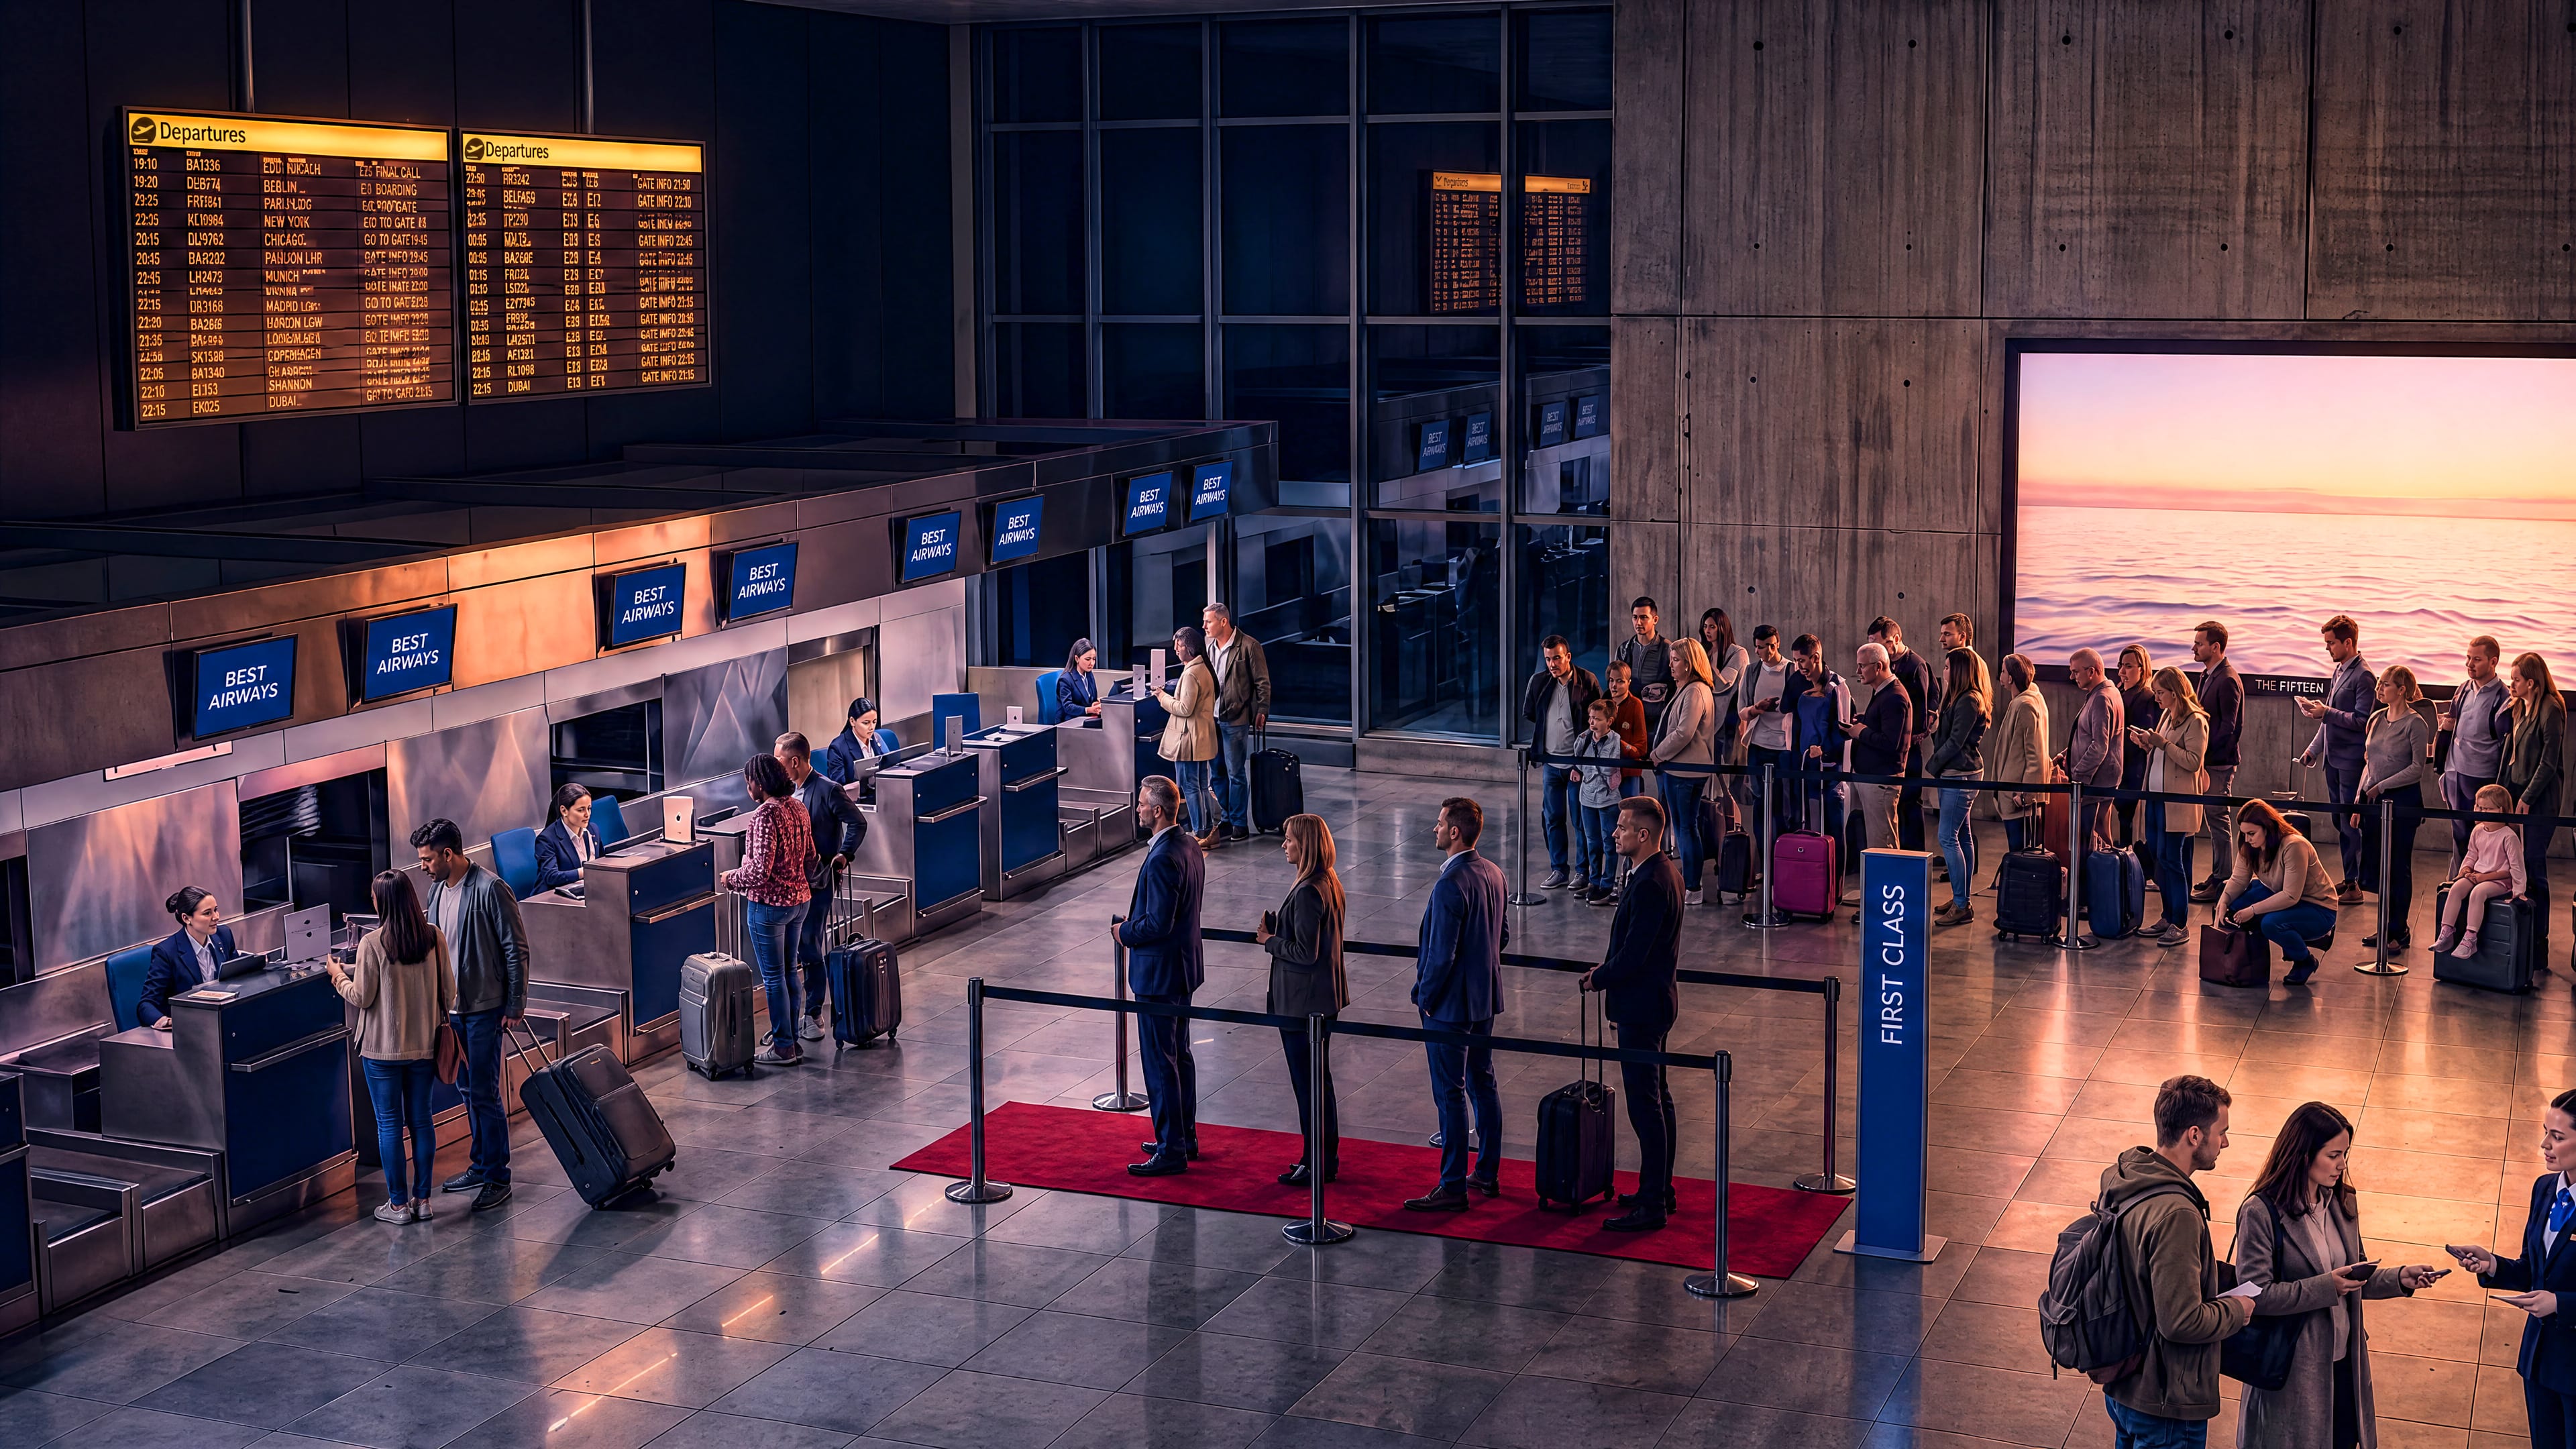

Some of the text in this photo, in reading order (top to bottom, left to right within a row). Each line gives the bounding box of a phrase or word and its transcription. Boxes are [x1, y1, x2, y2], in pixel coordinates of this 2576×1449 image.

[160, 121, 247, 145] Departures
[486, 142, 549, 162] Departures
[133, 158, 158, 170] 19:10
[186, 158, 221, 172] BA1336
[400, 166, 421, 179] CALL
[134, 175, 158, 189] 19:20
[376, 183, 417, 196] BOARDING
[466, 172, 485, 184] 22:50
[637, 177, 655, 190] GATE
[656, 178, 672, 190] INFO
[637, 194, 655, 207] GATE
[656, 195, 673, 208] INFO
[264, 215, 285, 227] NEW
[287, 215, 310, 228] YORK
[394, 217, 416, 229] GATE
[136, 232, 160, 246] 20:15
[364, 233, 376, 246] GO
[379, 233, 389, 246] TO
[639, 235, 656, 247] GATE
[305, 252, 323, 264] LHR
[189, 270, 223, 284] LH2473
[380, 297, 392, 309] TO
[639, 297, 657, 309] GATE
[303, 317, 323, 328] LGW
[640, 313, 658, 325] GATE
[640, 329, 658, 339] GATE
[641, 343, 659, 352] GATE
[641, 356, 659, 367] GATE
[192, 366, 225, 380] BA1340
[268, 378, 313, 391] SHANNON
[473, 382, 492, 395] 22:15
[508, 380, 531, 392] DUBAI
[568, 376, 581, 388] E13
[641, 371, 659, 382] GATE
[661, 370, 677, 382] INFO
[142, 404, 166, 417] 22:15
[193, 400, 220, 414] EK025
[1203, 476, 1222, 490] BEST
[1139, 488, 1161, 503] BEST
[1195, 489, 1226, 505] AIRWAYS
[1130, 501, 1164, 519] AIRWAYS
[1008, 514, 1030, 530] BEST
[921, 529, 946, 545] BEST
[998, 527, 1035, 546] AIRWAYS
[911, 543, 952, 562] AIRWAYS
[749, 563, 778, 582] BEST
[634, 585, 666, 604] BEST
[737, 577, 786, 600] AIRWAYS
[621, 600, 674, 624] AIRWAYS
[391, 633, 429, 653] BEST
[376, 649, 439, 675] AIRWAYS
[225, 665, 267, 688] BEST
[2255, 679, 2324, 694] THE FIFTEEN
[208, 682, 278, 710] AIRWAYS
[1881, 885, 1904, 1044] FIRST CLASS
